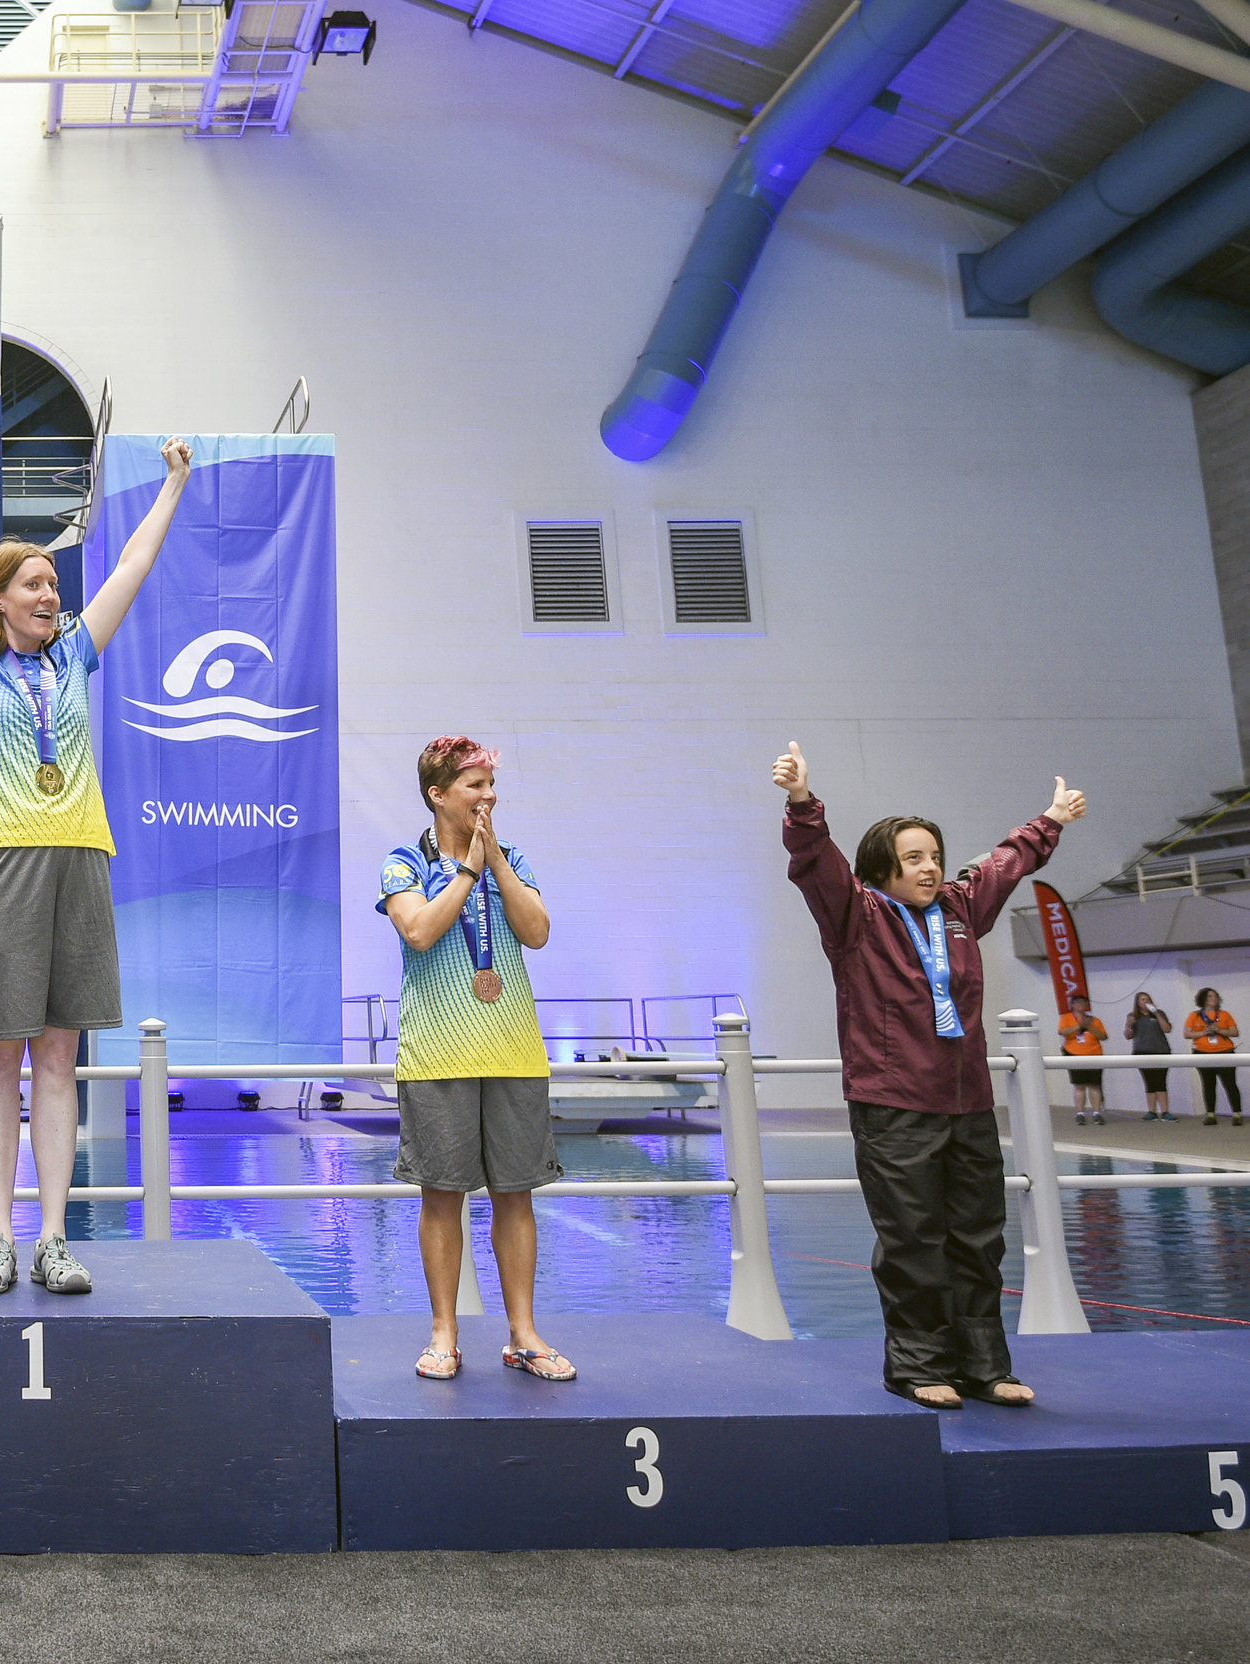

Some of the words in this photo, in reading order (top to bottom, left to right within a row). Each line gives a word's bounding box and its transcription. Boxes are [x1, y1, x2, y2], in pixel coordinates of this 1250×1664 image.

[25, 693, 39, 715] WITH
[141, 800, 299, 829] SWIMMING
[476, 892, 486, 911] RISE
[477, 912, 488, 937] WITH
[930, 914, 941, 932] RISE
[479, 939, 489, 954] US.
[933, 933, 945, 960] WITH
[21, 1321, 52, 1400] 1
[624, 1426, 664, 1508] 3
[1208, 1450, 1246, 1530] 5
